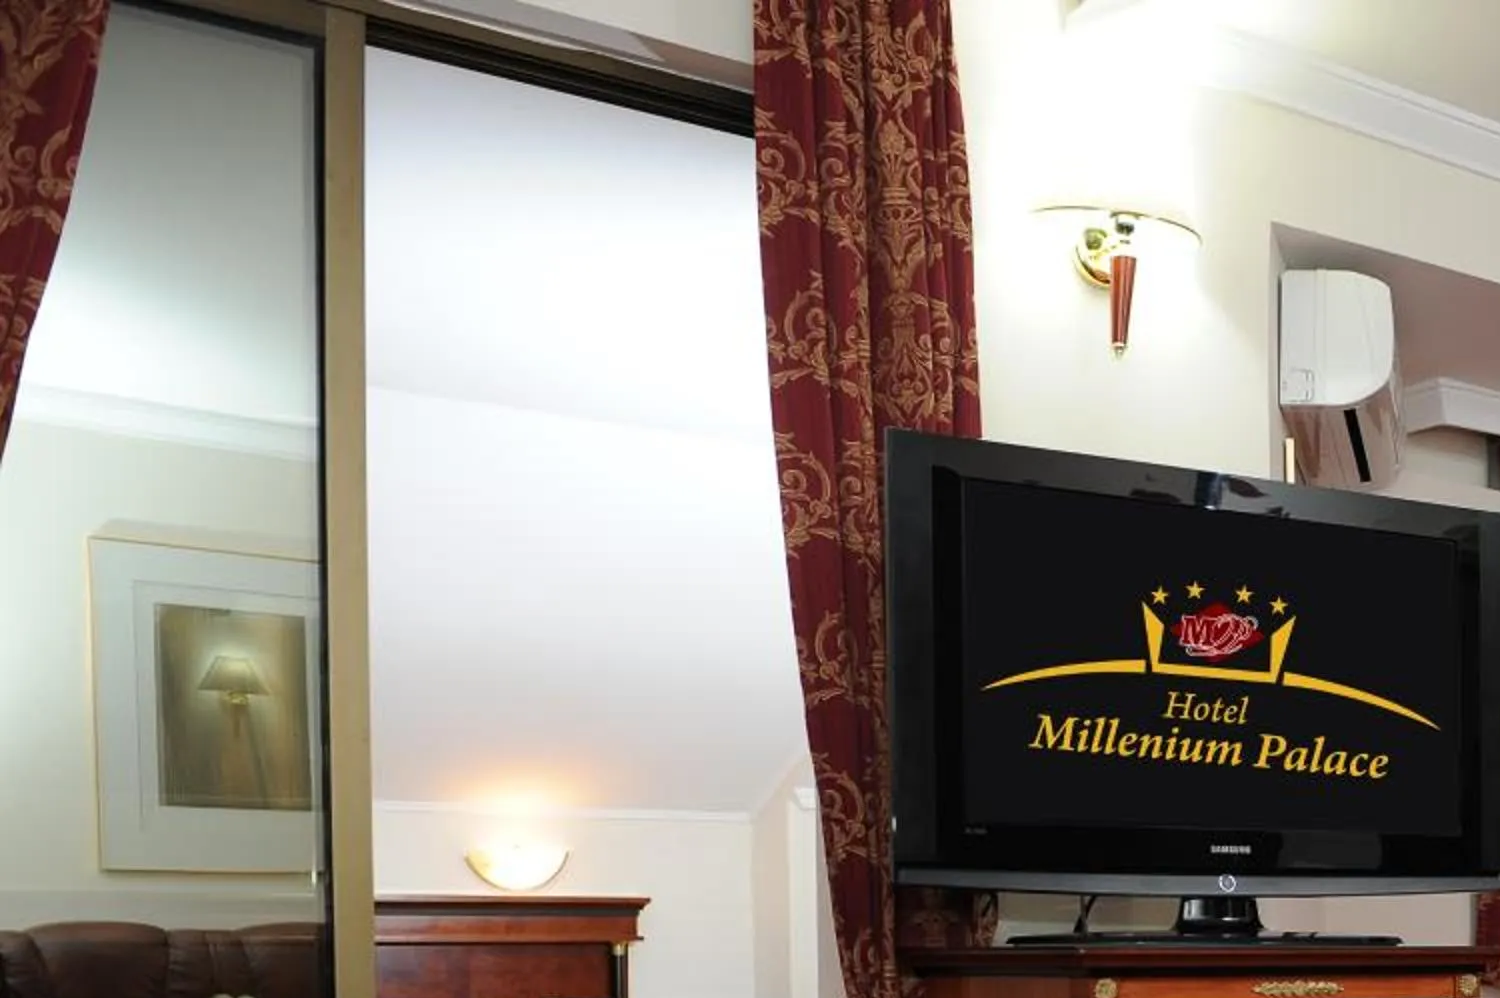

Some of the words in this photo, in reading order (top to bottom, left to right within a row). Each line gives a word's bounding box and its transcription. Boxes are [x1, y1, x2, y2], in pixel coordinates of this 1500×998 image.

[1164, 691, 1249, 725] Hotel
[1029, 714, 1242, 767] Millenium
[1253, 734, 1389, 779] Palace
